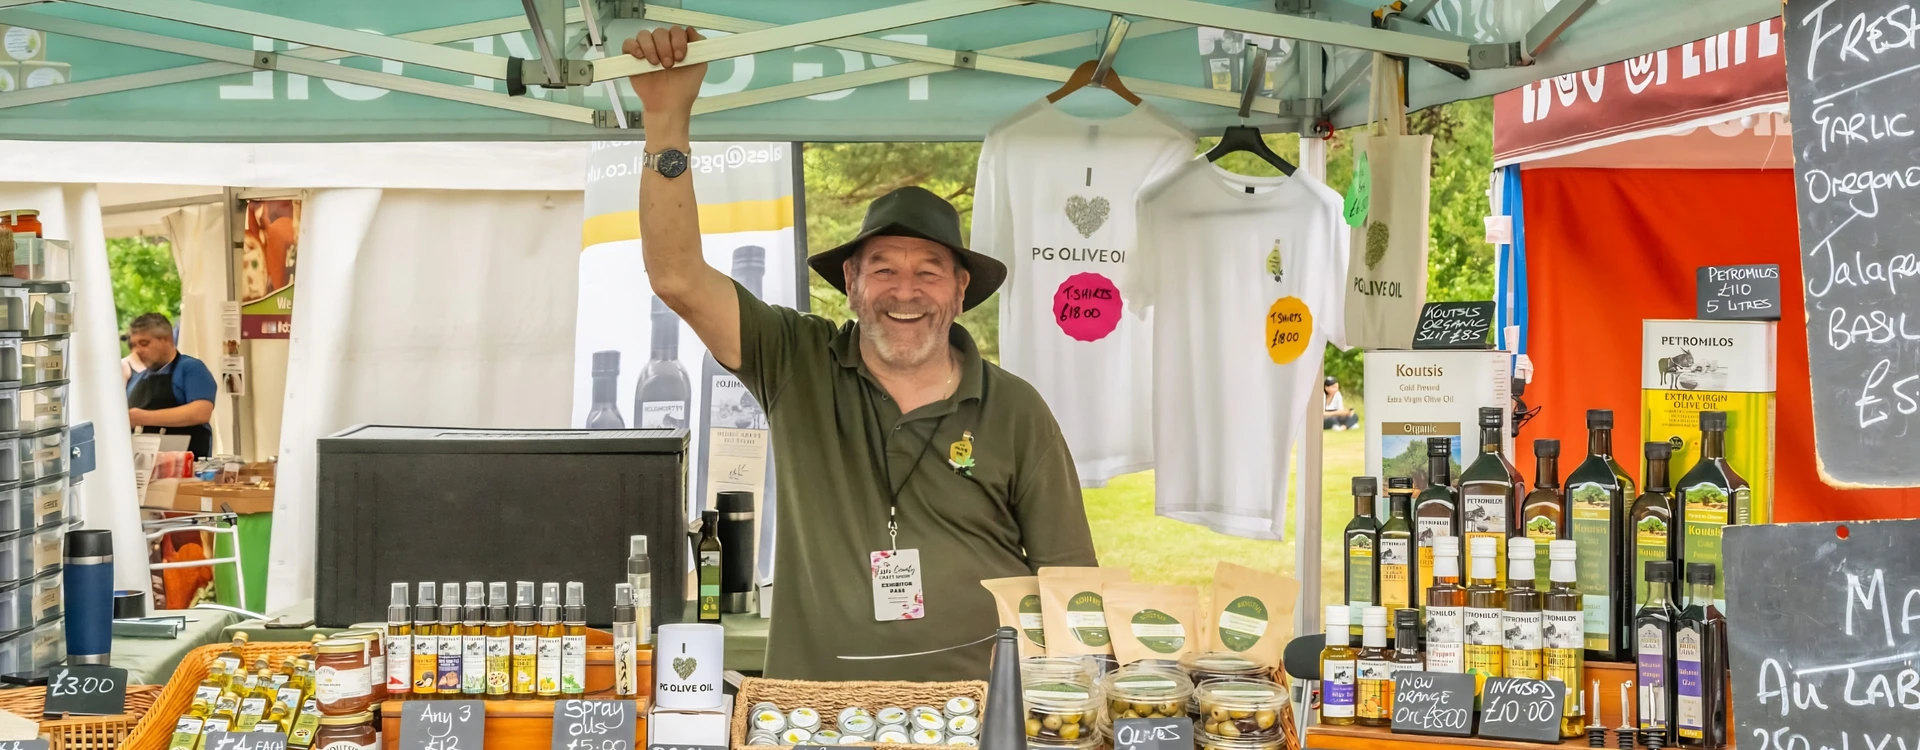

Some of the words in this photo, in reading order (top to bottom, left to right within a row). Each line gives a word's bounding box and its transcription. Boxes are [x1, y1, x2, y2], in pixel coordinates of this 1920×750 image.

[1812, 103, 1915, 152] GARLIC
[1032, 247, 1054, 261] PG
[1058, 248, 1109, 263] OLIVE
[1110, 250, 1126, 263] OI
[1708, 266, 1779, 283] PETROMILOS
[1388, 281, 1402, 298] OIL
[1717, 282, 1752, 298] £110
[1706, 300, 1720, 313] 5
[1728, 299, 1773, 311] LITRES
[1422, 319, 1488, 331] ORGANIC
[1828, 306, 1920, 351] BASIL
[1661, 335, 1734, 348] PETROMILOS
[1396, 364, 1444, 378] Koutsis
[1399, 383, 1415, 392] Cold
[1664, 392, 1694, 402] EXTRA
[1697, 394, 1728, 403] VIRGIN
[1673, 401, 1700, 410] OLIVE
[1702, 402, 1718, 411] OIL
[1403, 423, 1437, 435] Organic
[50, 668, 114, 697] £3.00
[670, 684, 697, 693] OLIVE
[700, 683, 713, 692] OIL
[1397, 691, 1453, 704] ORANGE
[564, 699, 624, 729] Spray
[1485, 696, 1555, 723] £10.00
[420, 703, 452, 738] Any
[459, 704, 471, 722] 3
